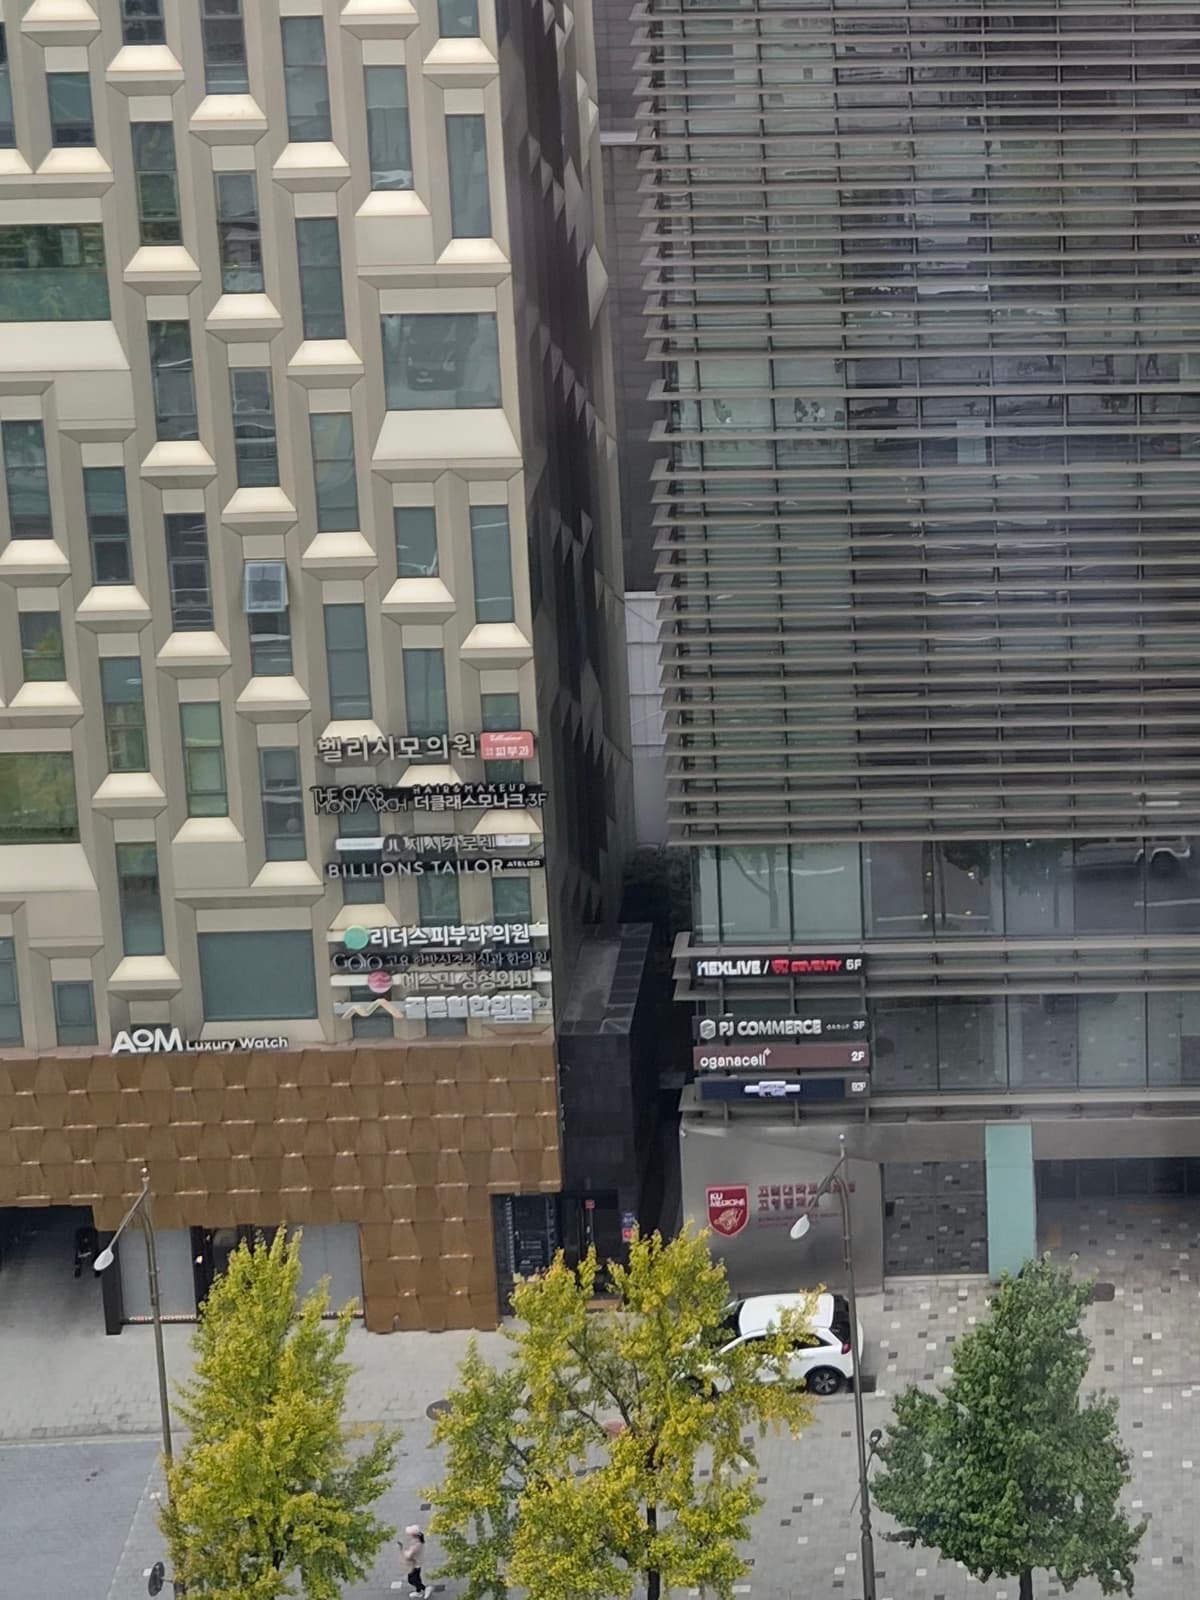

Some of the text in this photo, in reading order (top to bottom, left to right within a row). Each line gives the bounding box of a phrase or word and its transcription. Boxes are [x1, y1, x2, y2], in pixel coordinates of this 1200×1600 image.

[317, 733, 476, 763] 벨리시모의원
[414, 793, 547, 811] 더클래스모나크 3F
[328, 861, 424, 878] BILLIONS
[432, 859, 503, 874] TAILOR
[719, 1021, 734, 1036] PJ
[737, 1020, 822, 1036] COMMERCE
[186, 1039, 235, 1052] Luxury
[238, 1036, 288, 1049] Watch
[700, 1050, 864, 1069] oganacell 2F
